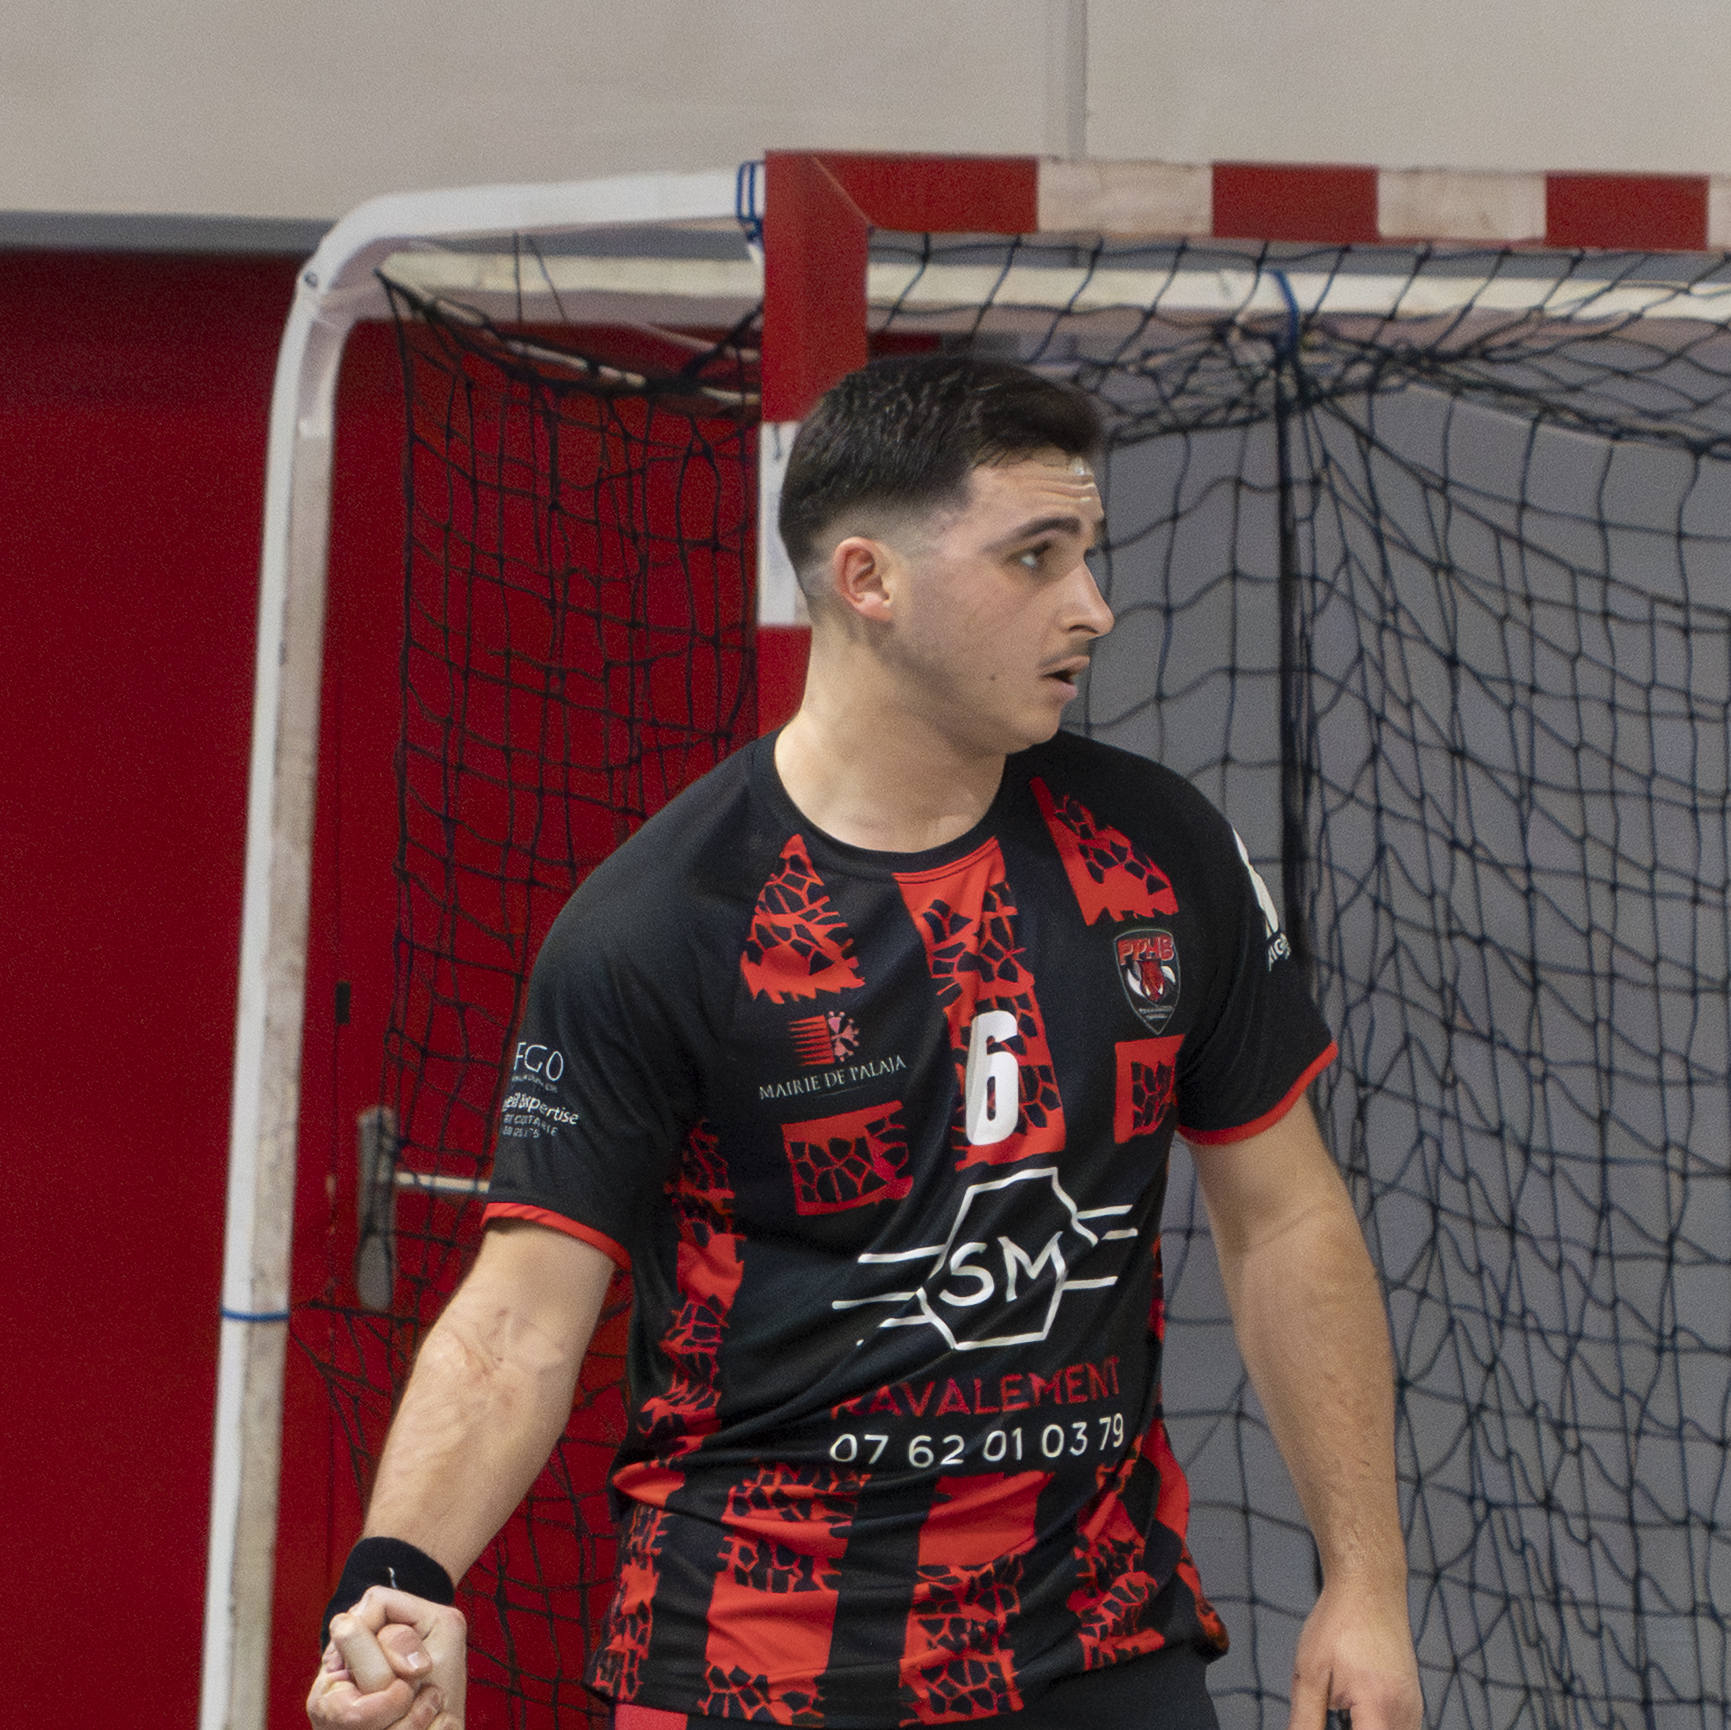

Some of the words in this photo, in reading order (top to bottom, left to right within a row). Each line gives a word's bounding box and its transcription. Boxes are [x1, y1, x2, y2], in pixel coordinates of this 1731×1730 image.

[759, 1074, 822, 1100] MAIRIE
[824, 1069, 846, 1088] DE
[849, 1054, 907, 1082] PALAJA
[965, 1010, 1020, 1146] 6
[938, 1231, 1068, 1307] SM
[829, 1433, 890, 1465] 07
[908, 1435, 966, 1468] 62
[982, 1427, 1023, 1463] 01
[1041, 1421, 1089, 1457] 03
[1098, 1412, 1125, 1451] 79
